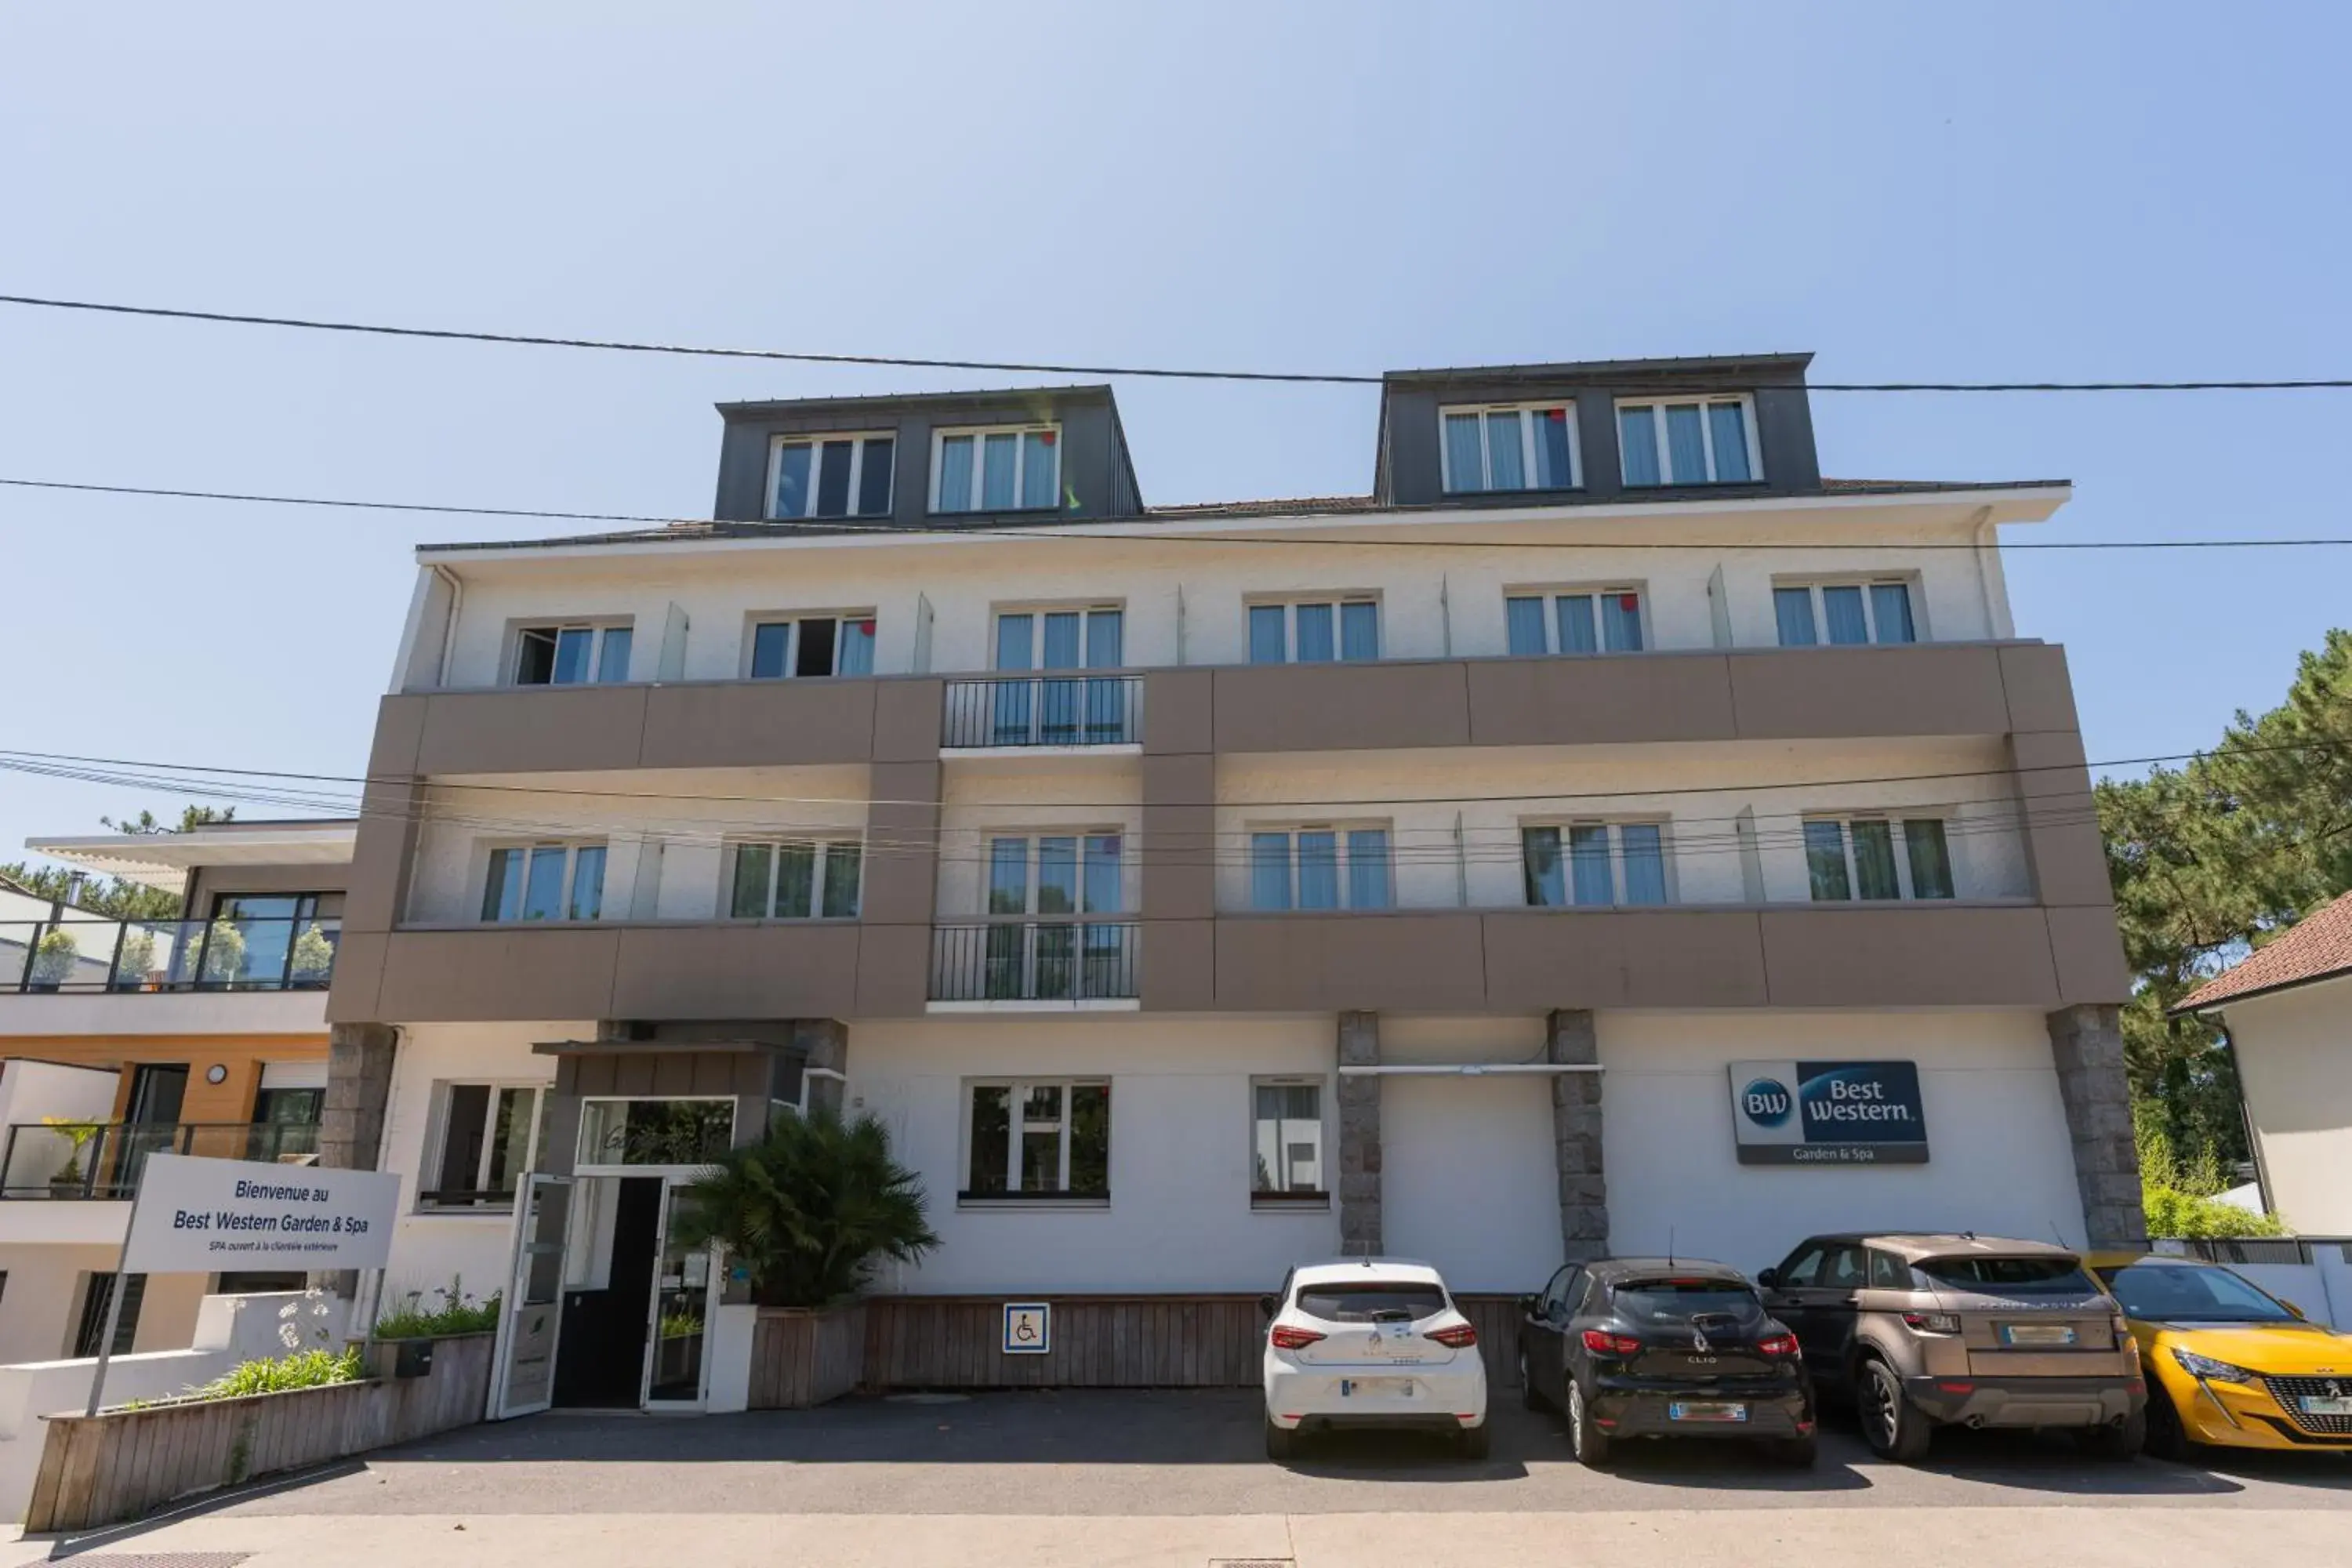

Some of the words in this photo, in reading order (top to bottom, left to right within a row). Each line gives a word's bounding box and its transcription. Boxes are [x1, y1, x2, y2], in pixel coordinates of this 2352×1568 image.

[1831, 1080, 1884, 1099] Best
[1748, 1094, 1787, 1114] BW
[1793, 1148, 1837, 1160] Garden
[1852, 1148, 1875, 1161] Spa
[235, 1180, 310, 1201] Bienvenue
[312, 1188, 329, 1202] au
[173, 1210, 211, 1229] Best
[216, 1210, 277, 1231] Western
[281, 1214, 330, 1232] Garden
[332, 1216, 342, 1232] &
[344, 1216, 368, 1235] Spa
[209, 1241, 226, 1250] SPA
[227, 1241, 255, 1250] ouvert
[1688, 1356, 1718, 1364] CLIO
